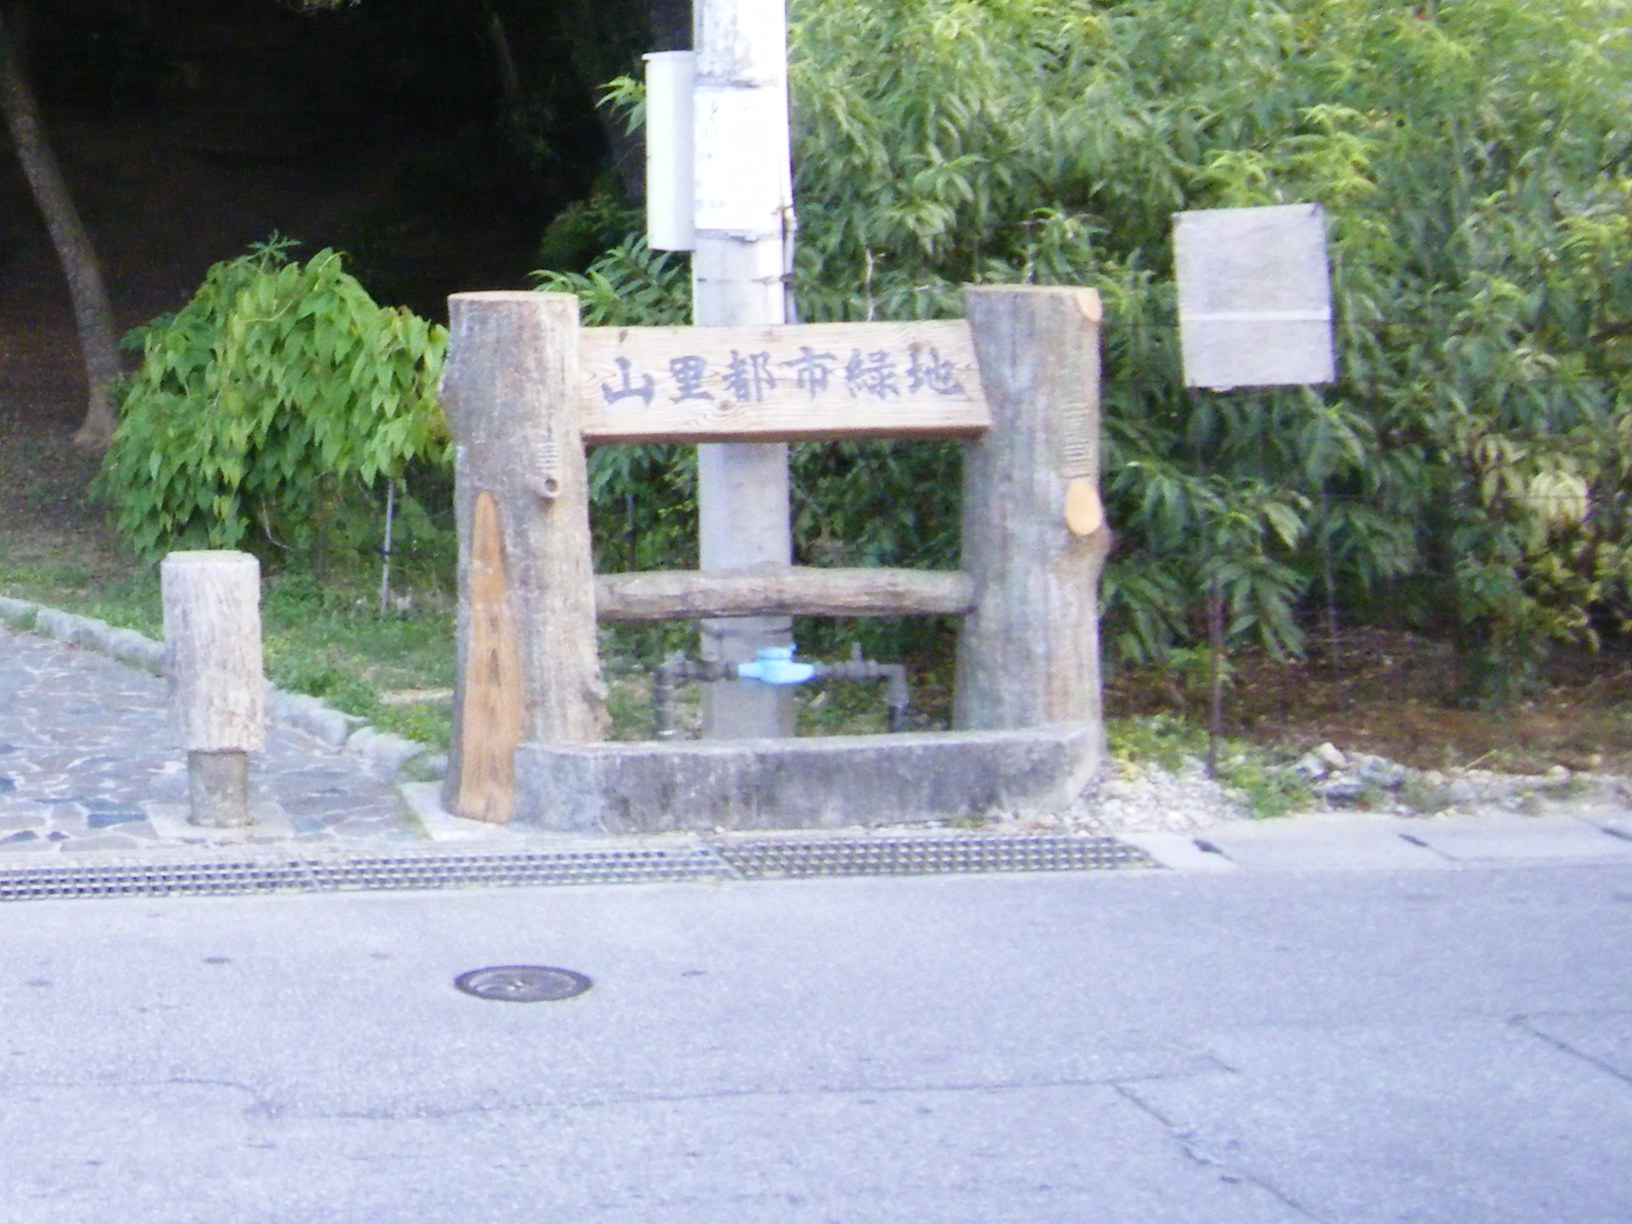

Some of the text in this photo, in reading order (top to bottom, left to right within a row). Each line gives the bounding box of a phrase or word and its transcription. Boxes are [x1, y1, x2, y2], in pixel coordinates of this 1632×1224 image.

[600, 345, 966, 407] 山里都市緑地
